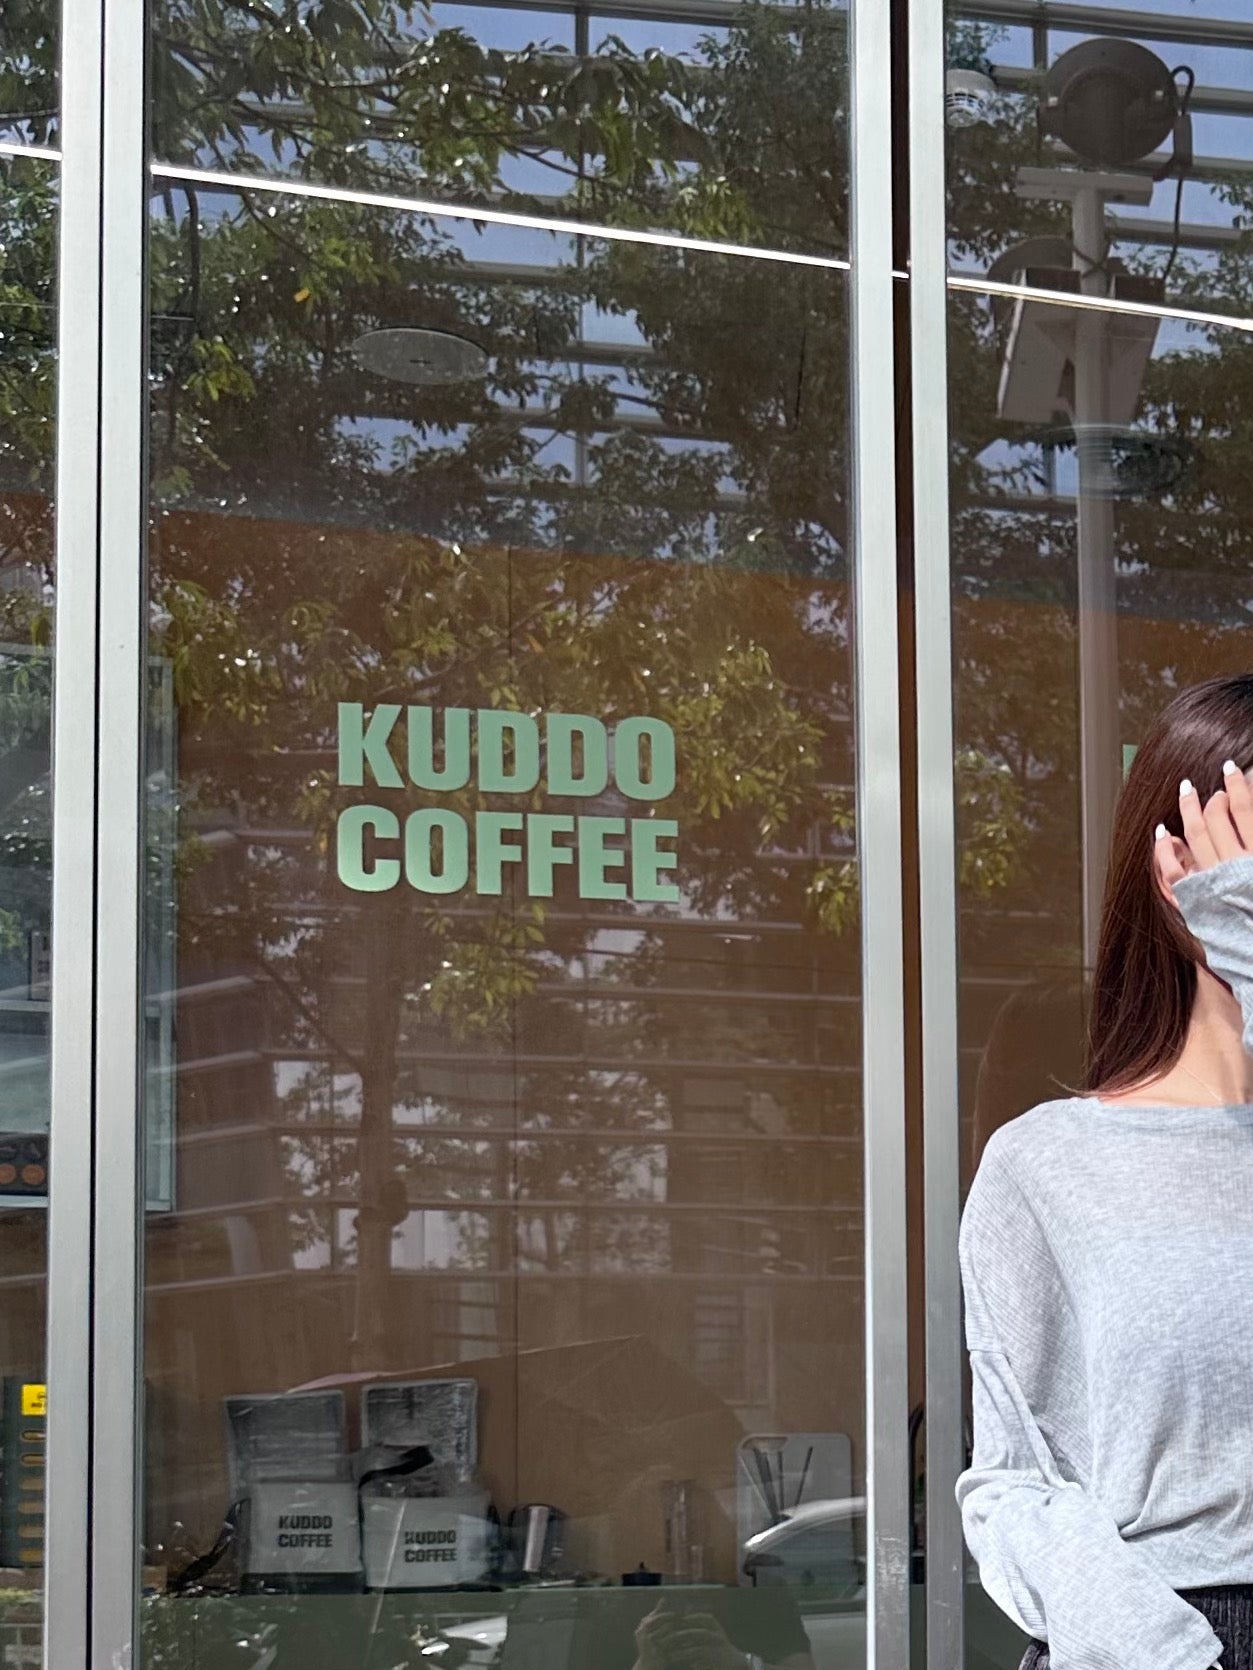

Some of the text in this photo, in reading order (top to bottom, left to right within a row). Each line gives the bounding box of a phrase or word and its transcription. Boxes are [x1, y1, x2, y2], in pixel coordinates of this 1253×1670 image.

[337, 701, 677, 801] KUDDO
[336, 804, 681, 903] COFFEE
[278, 1515, 333, 1530] KUDDO
[278, 1533, 333, 1548] COFFEE
[404, 1548, 456, 1563] COFFEE
